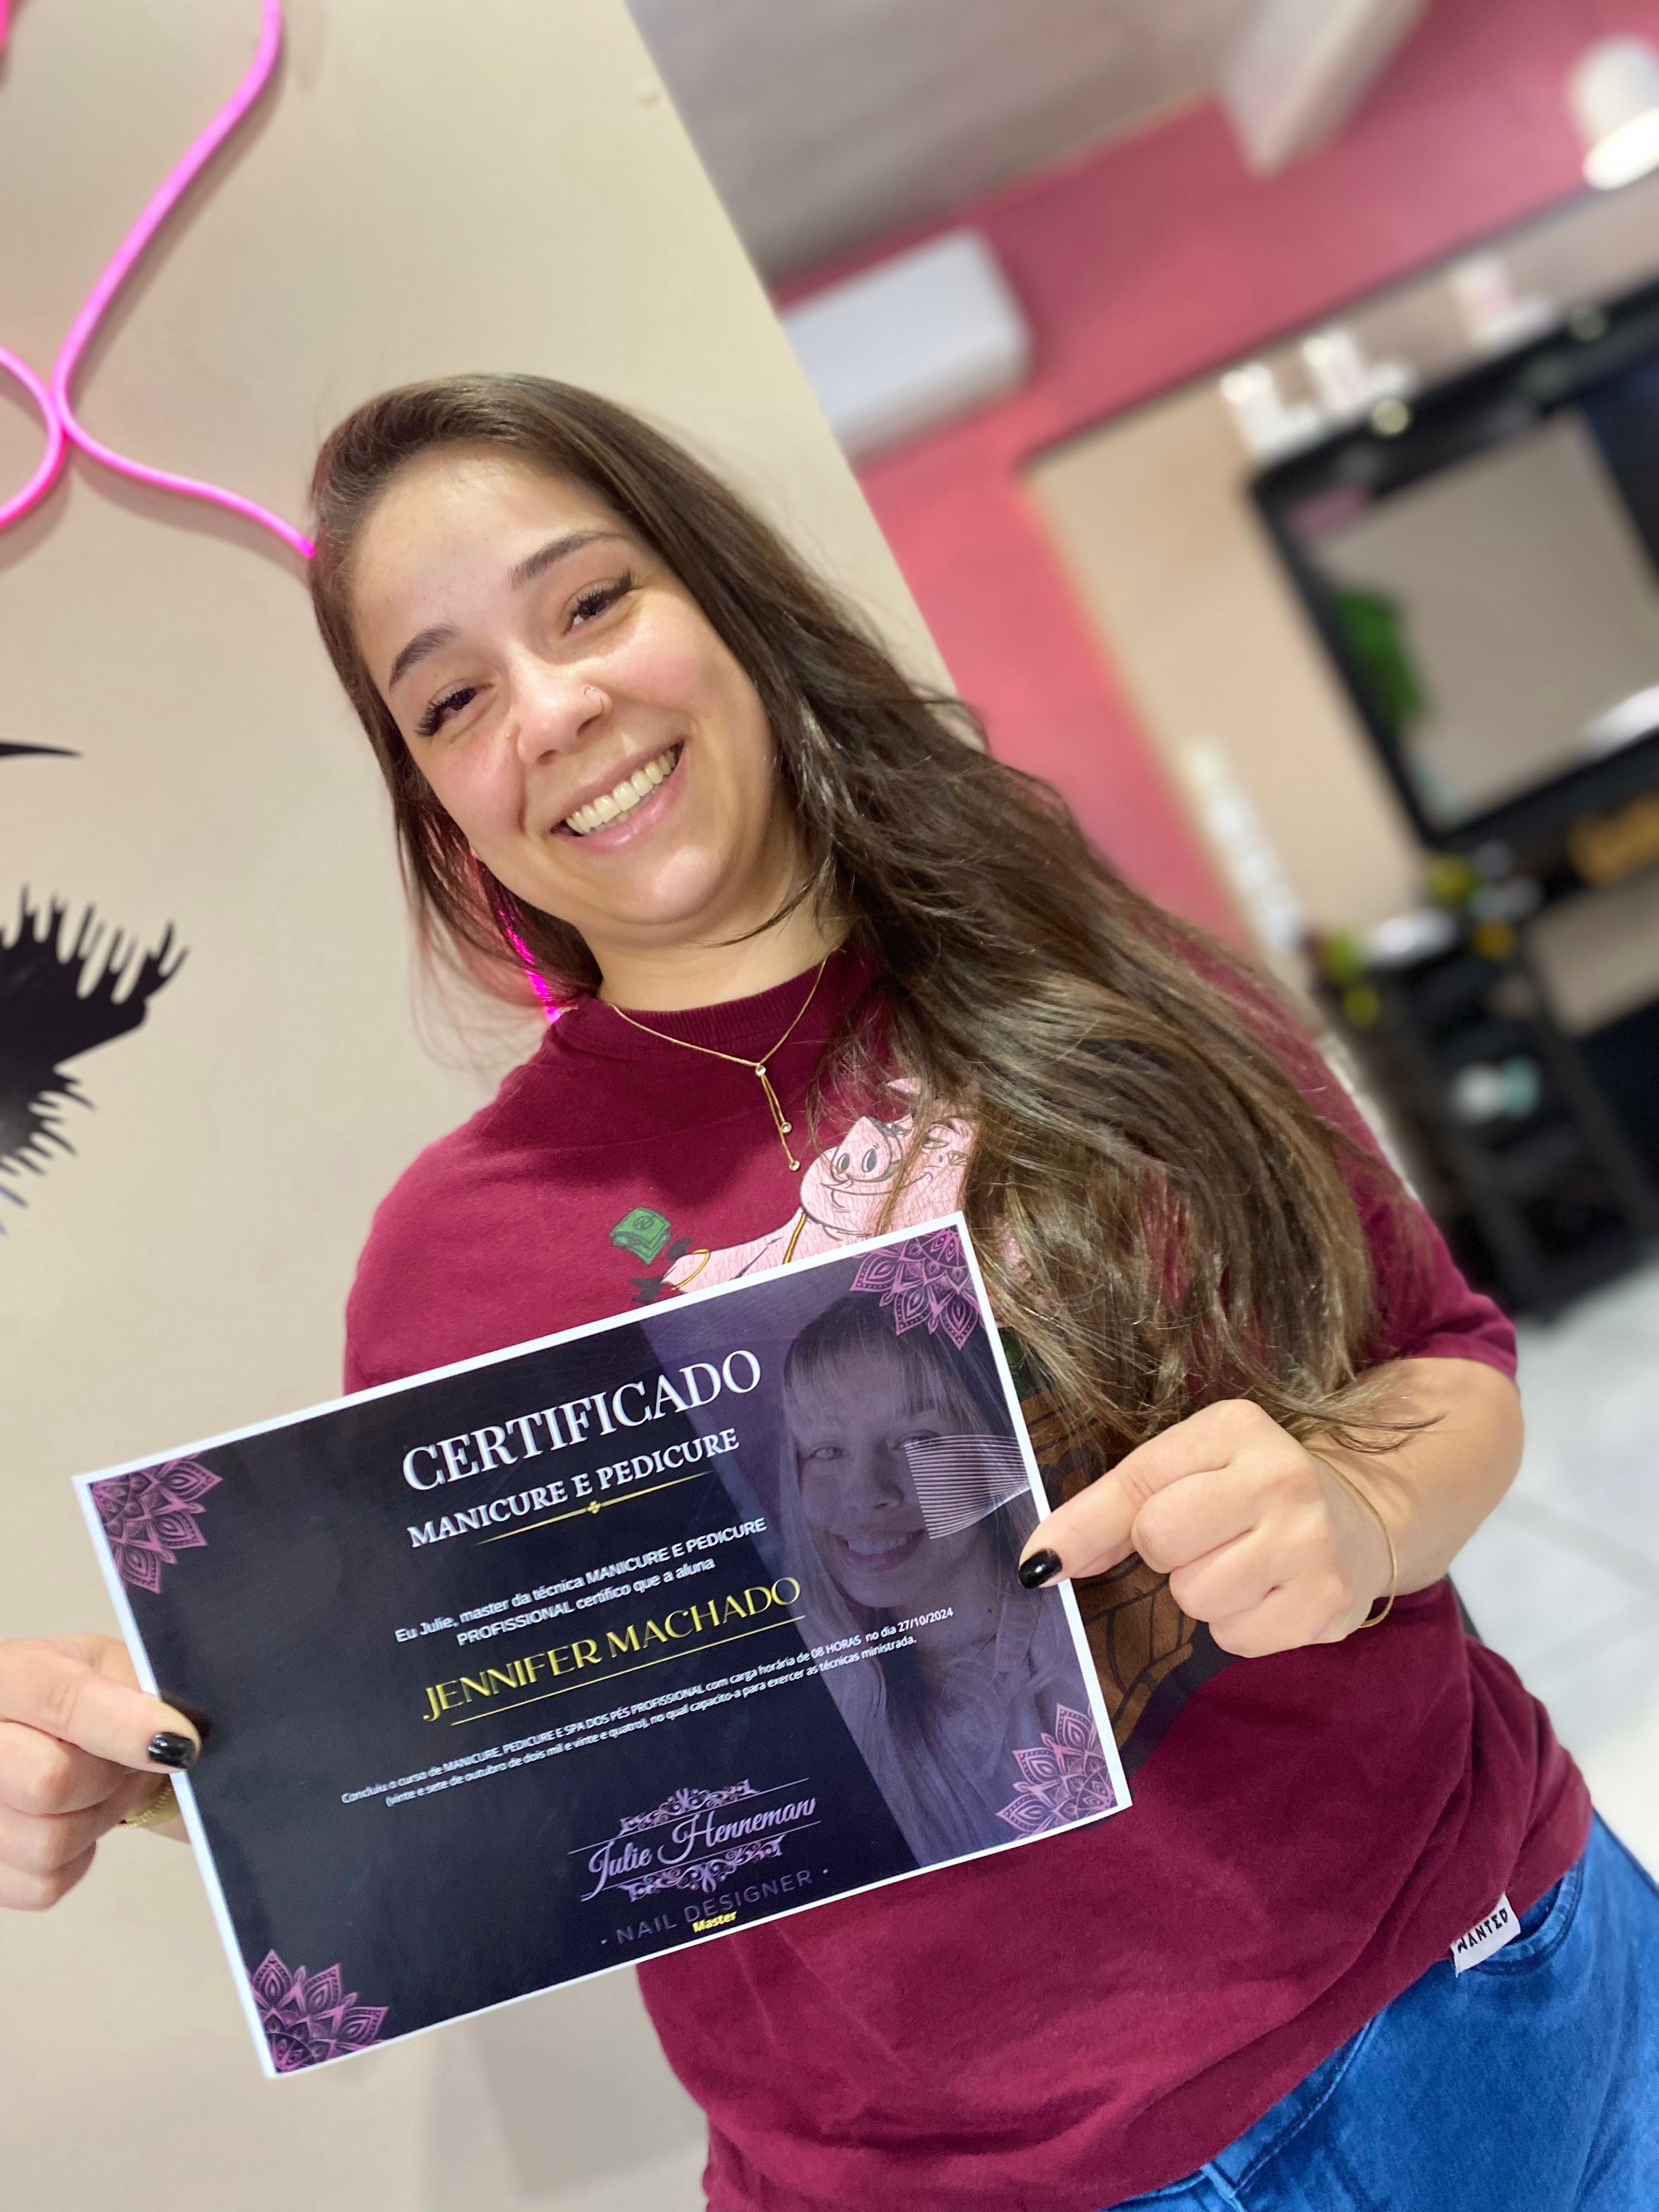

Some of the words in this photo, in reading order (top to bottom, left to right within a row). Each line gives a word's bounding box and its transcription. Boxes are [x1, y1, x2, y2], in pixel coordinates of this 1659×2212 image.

[403, 1351, 760, 1489] CERTIFICADO
[407, 1481, 568, 1547] MANICURE
[571, 1474, 592, 1497] E
[596, 1429, 739, 1489] PEDICURE
[394, 1628, 419, 1643] Eu
[420, 1617, 459, 1635] Julie,
[459, 1599, 510, 1623] master
[511, 1593, 533, 1607] da
[532, 1577, 586, 1601] técnica
[585, 1547, 672, 1584] MANICURE
[671, 1542, 686, 1558] E
[685, 1517, 768, 1553] PEDICURE
[456, 1601, 575, 1646] PROFISSIONAL
[575, 1584, 632, 1609] certifico
[633, 1575, 661, 1593] que
[663, 1571, 675, 1583] a
[675, 1558, 716, 1579] aluna
[341, 1784, 390, 1803] Concluiu
[388, 1780, 399, 1790] o
[397, 1771, 428, 1786] curso
[427, 1766, 444, 1777] de
[502, 1730, 556, 1754] PEDICURE
[555, 1727, 565, 1738] E
[563, 1722, 586, 1736] SPA
[585, 1713, 611, 1729] DOS
[609, 1706, 631, 1722] PÉS
[630, 1684, 706, 1715] PROFISSIONAL
[705, 1678, 729, 1691] com
[729, 1669, 758, 1684] carga
[758, 1657, 796, 1675] horária
[796, 1652, 810, 1663] de
[810, 1646, 825, 1659] 08
[825, 1634, 862, 1655] HORAS
[865, 1632, 879, 1643] no
[881, 1626, 897, 1638] dia
[897, 1607, 953, 1633] 27/10/2024
[424, 1640, 602, 1721] JENNIFER
[607, 1578, 799, 1657] MACHADO
[416, 1787, 426, 1796] e
[425, 1780, 450, 1794] sete
[448, 1775, 465, 1786] de
[464, 1762, 508, 1781] outubro
[507, 1757, 524, 1768] de
[522, 1750, 547, 1763] dois
[545, 1742, 565, 1757] mil
[563, 1742, 574, 1751] e
[572, 1734, 600, 1748] vinte
[599, 1731, 609, 1740] e
[650, 1713, 665, 1724] no
[665, 1703, 690, 1721] qual
[689, 1689, 742, 1712] capacito-a
[742, 1681, 766, 1699] para
[767, 1669, 805, 1688] exercer
[806, 1665, 819, 1676] as
[819, 1652, 860, 1672] técnicas
[861, 1635, 917, 1659] ministrada.
[581, 1841, 652, 1901] Julie
[616, 1914, 677, 1944] NAIL
[684, 1870, 813, 1923] DESIGNER
[692, 1911, 737, 1933] Master
[1457, 1908, 1508, 1953] WANTED
